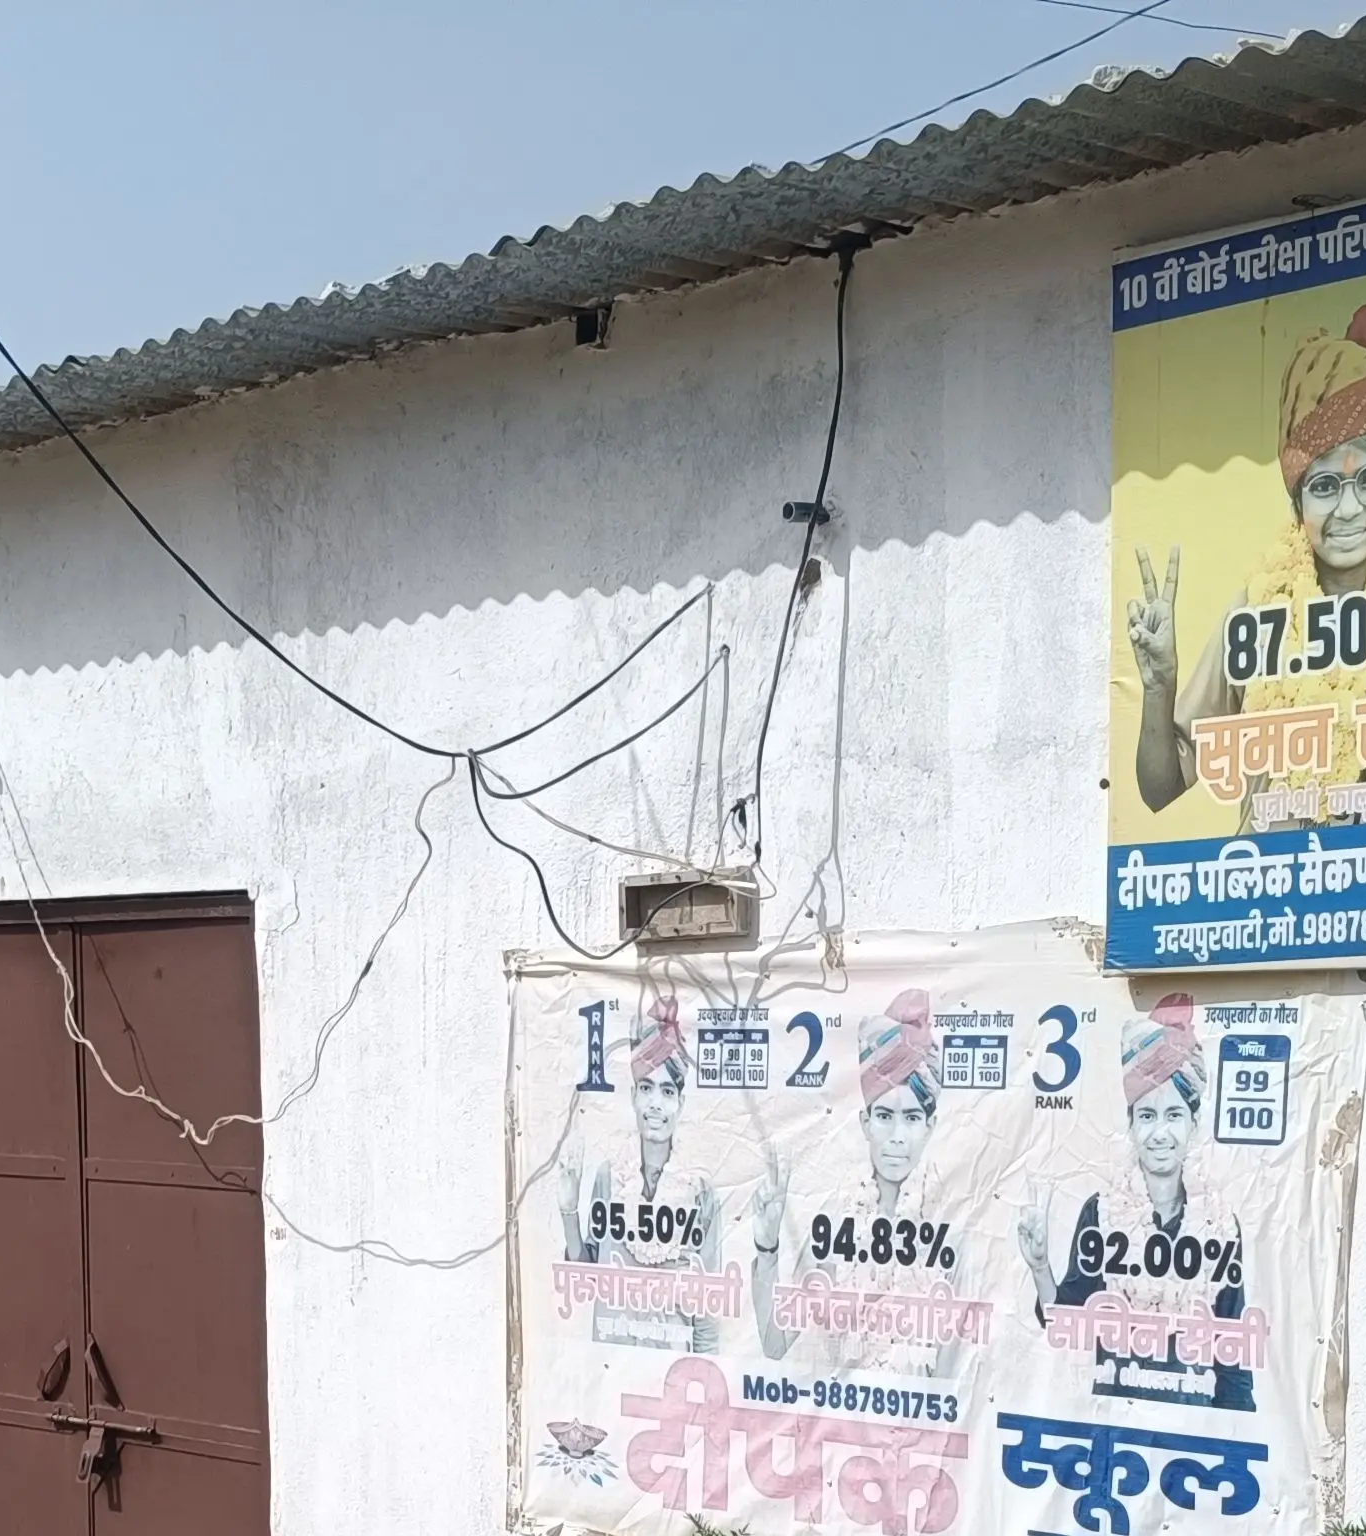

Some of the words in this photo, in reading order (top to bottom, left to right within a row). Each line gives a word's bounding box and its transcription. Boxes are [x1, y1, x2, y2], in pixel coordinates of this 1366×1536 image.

[1120, 278, 1147, 313] 10
[1154, 256, 1181, 303] वीं
[1185, 243, 1230, 296] बोर्ड
[1235, 226, 1310, 285] परीक्षा
[1191, 699, 1336, 805] सुमन
[1117, 852, 1191, 912] दीपक
[1196, 842, 1292, 908] पब्लिक
[933, 1010, 978, 1032] उदयपुरवाटी
[980, 1014, 990, 1027] का
[993, 1010, 1014, 1027] गौरव
[1204, 1004, 1256, 1029] उदयपुरवाटी
[1259, 1008, 1271, 1023] का
[1274, 1004, 1298, 1024] गौरव
[703, 1048, 715, 1060] 99
[948, 1053, 968, 1063] 100
[701, 1068, 717, 1080] 100
[726, 1069, 741, 1081] 100
[748, 1070, 764, 1081] 100
[795, 1073, 823, 1086] RANK
[947, 1070, 968, 1081] 100
[979, 1071, 1000, 1081] 100
[1235, 1070, 1269, 1093] 99
[1035, 1096, 1073, 1110] RANK
[1227, 1107, 1273, 1129] 100
[590, 1200, 703, 1246] 95.50%
[811, 1214, 955, 1269] 94.83%
[1078, 1231, 1242, 1284] 92.00%
[743, 1374, 958, 1421] Mob-9887891753
[997, 1411, 1269, 1536] स्कूल
